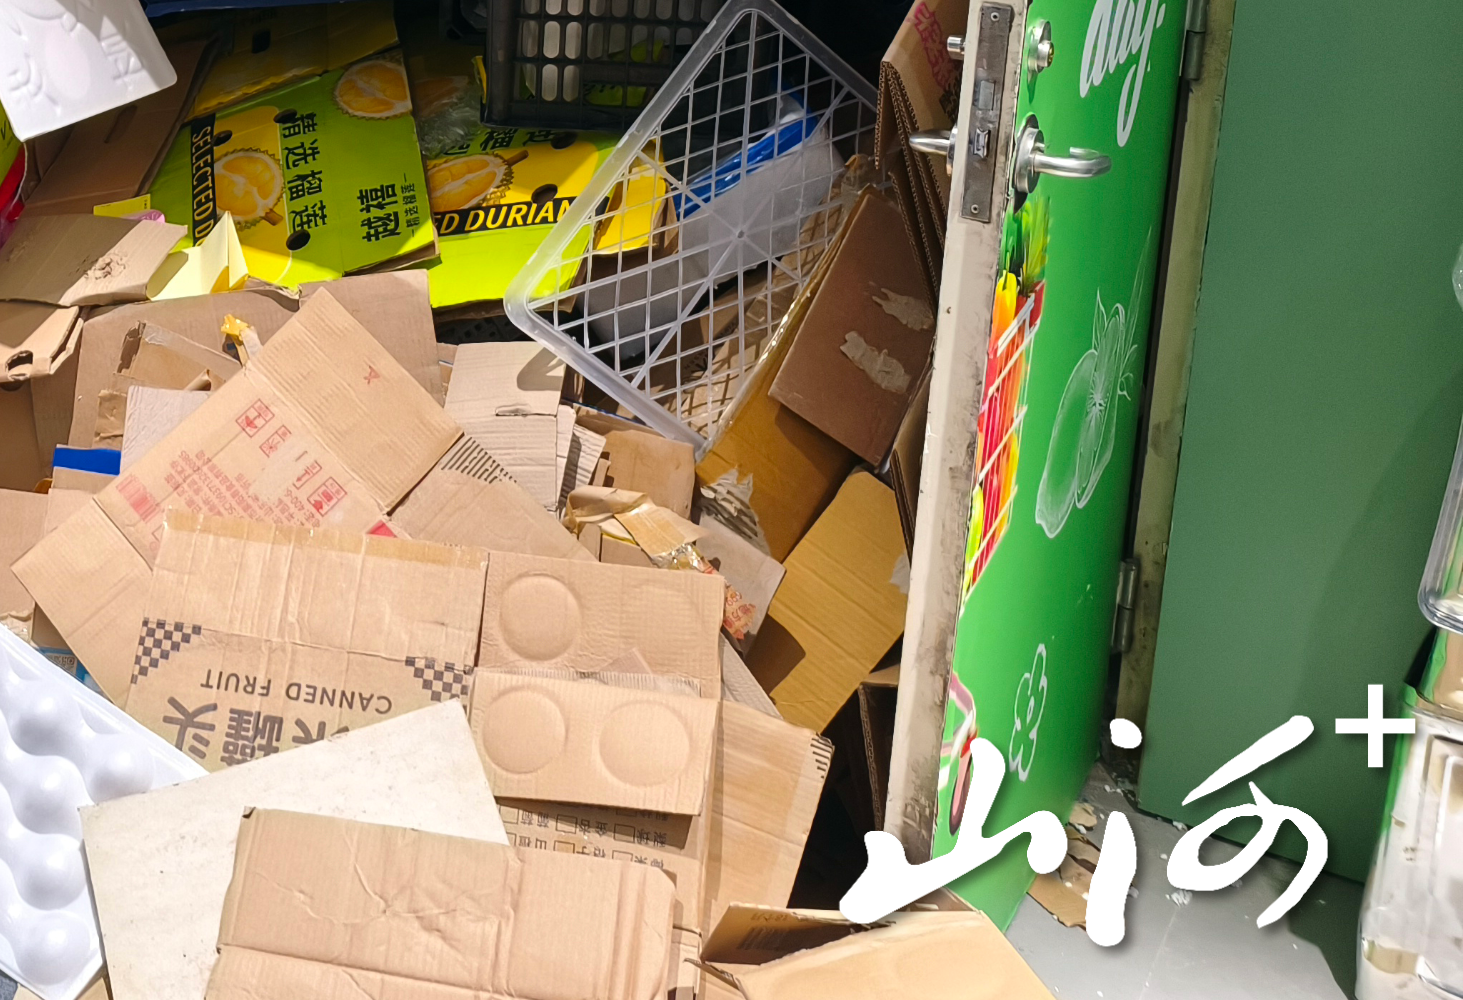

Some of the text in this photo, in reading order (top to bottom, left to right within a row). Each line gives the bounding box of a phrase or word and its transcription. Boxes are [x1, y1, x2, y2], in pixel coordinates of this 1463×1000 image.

[191, 125, 215, 222] SELECTED
[281, 110, 328, 234] 精选榴莲
[200, 668, 393, 714] CANNED FRUIT
